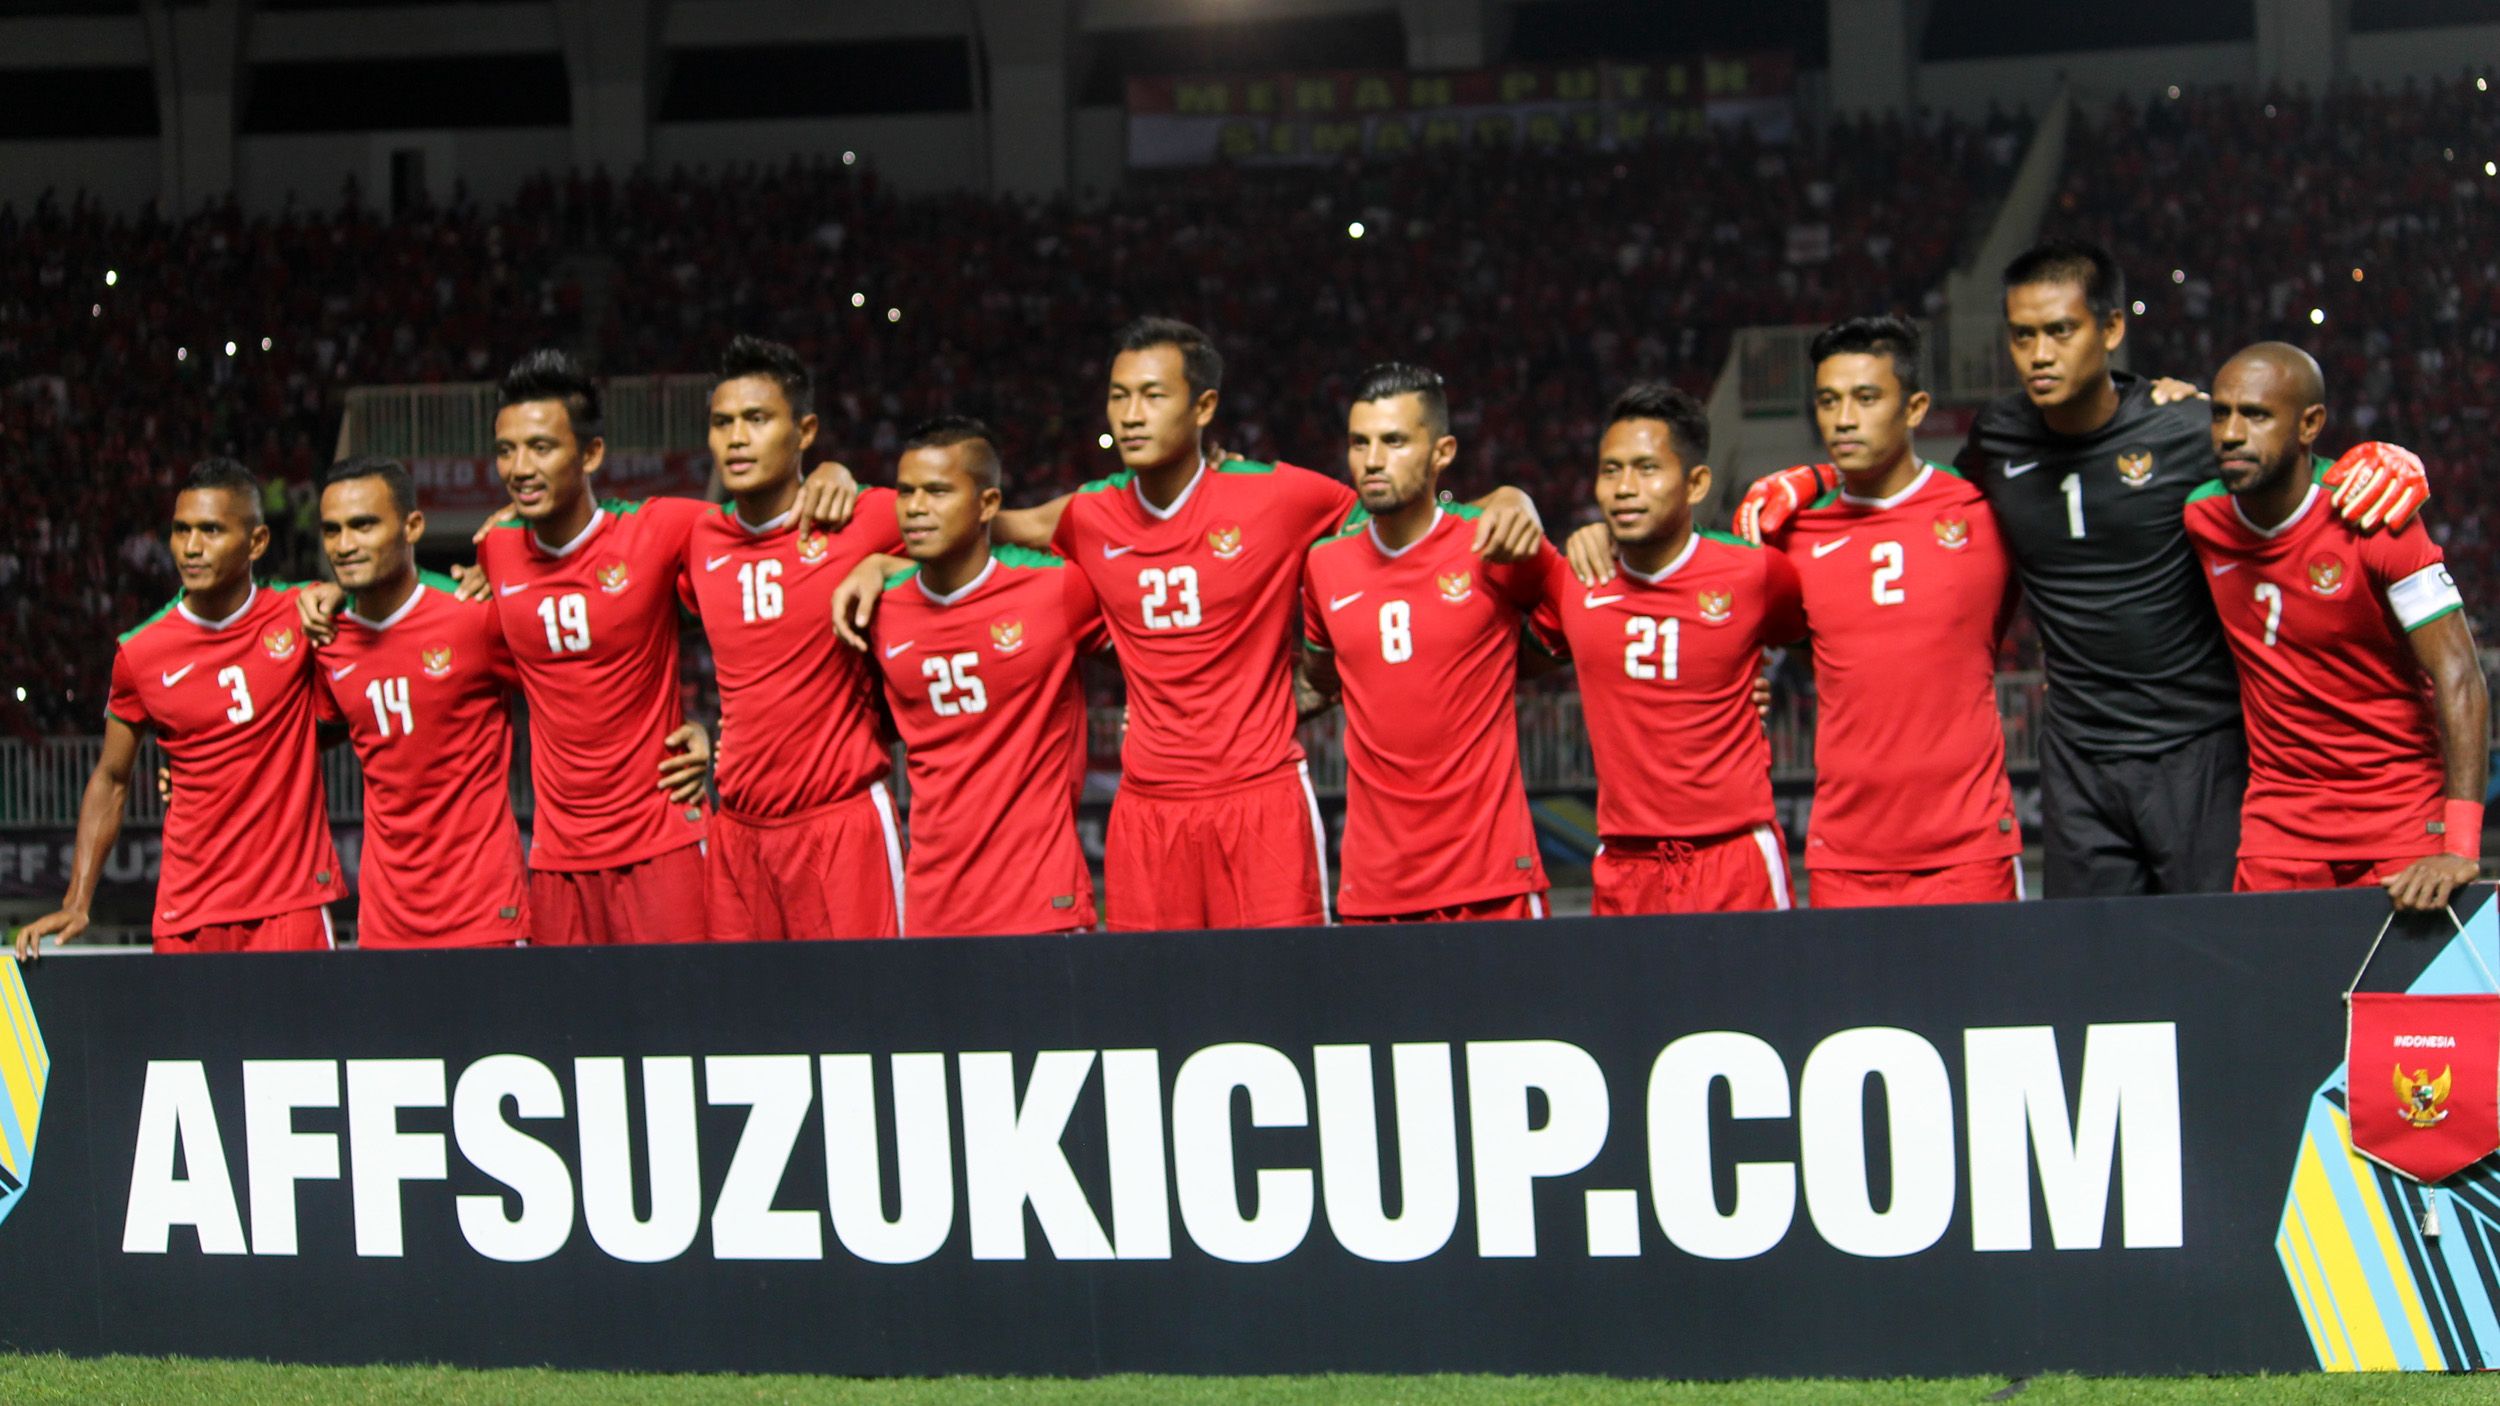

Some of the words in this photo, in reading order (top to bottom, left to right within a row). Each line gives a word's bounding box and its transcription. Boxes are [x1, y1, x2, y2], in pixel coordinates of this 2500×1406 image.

[2059, 472, 2086, 539] 1
[735, 557, 785, 625] 16
[1137, 564, 1202, 631] 23
[1869, 539, 1907, 607] 2
[536, 591, 592, 654] 19
[1377, 599, 1414, 665] 8
[2253, 582, 2283, 647] 7
[1622, 616, 1681, 682] 21
[216, 663, 254, 726] 3
[364, 675, 415, 738] 14
[921, 650, 988, 717] 25
[2393, 1035, 2456, 1048] INDONESIA
[121, 1021, 2184, 1264] AFFSUZUKICUP.COM
